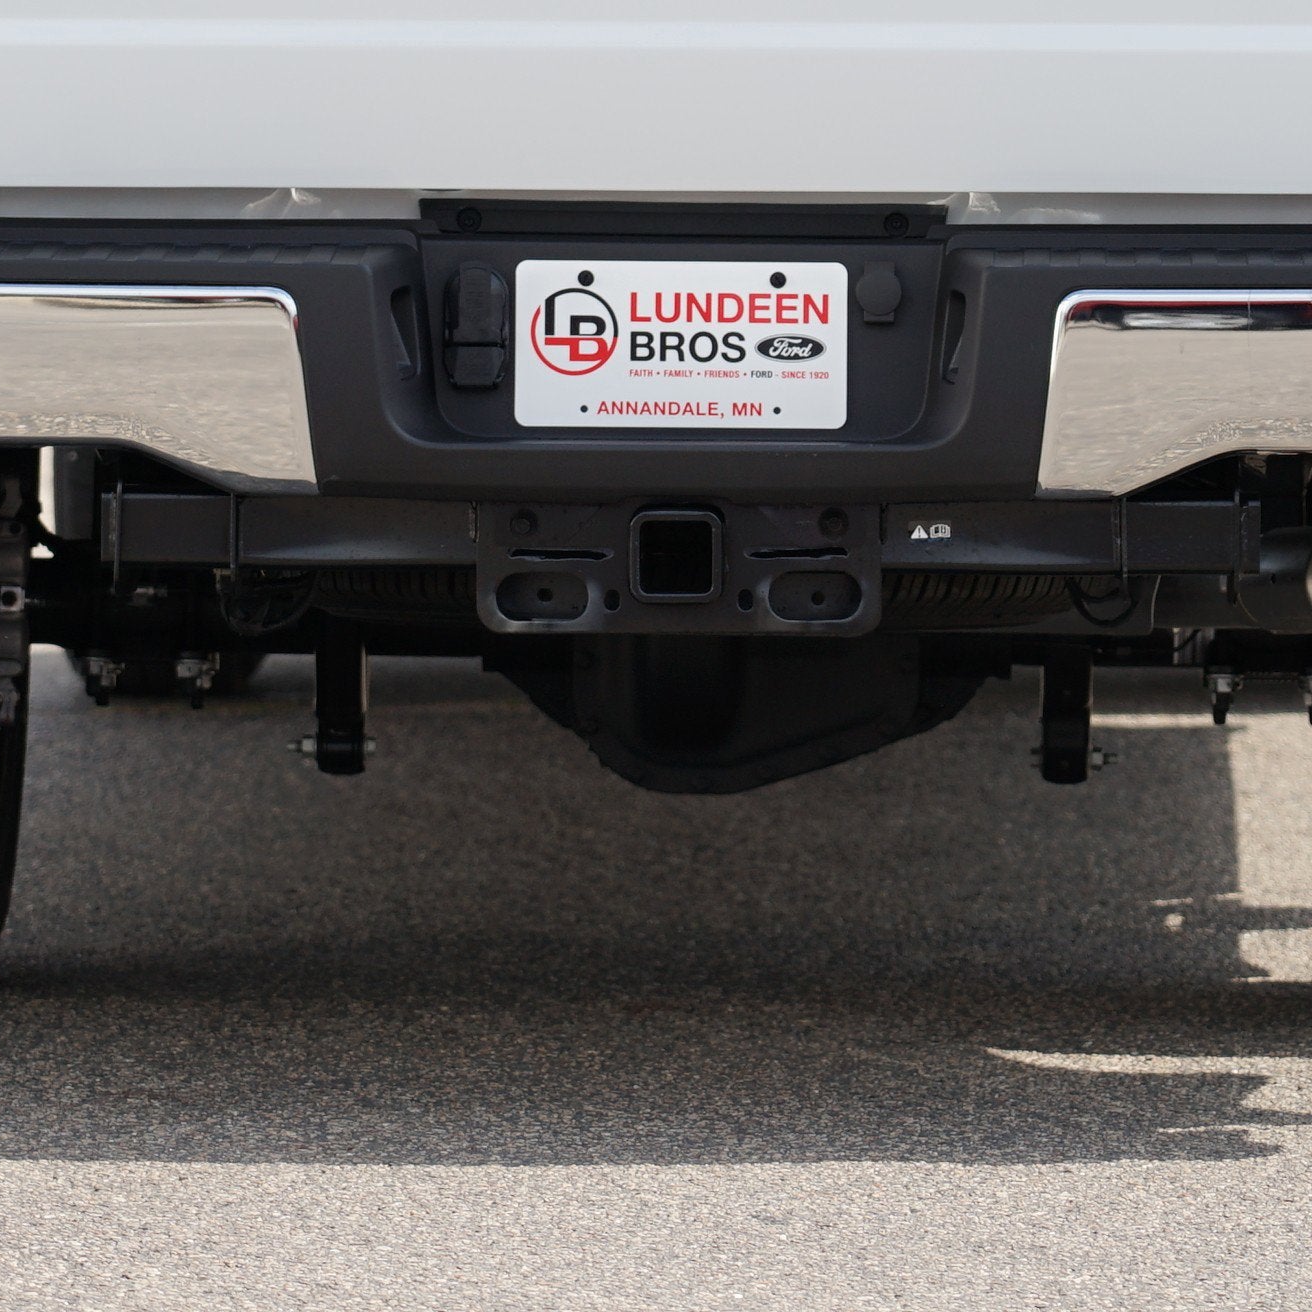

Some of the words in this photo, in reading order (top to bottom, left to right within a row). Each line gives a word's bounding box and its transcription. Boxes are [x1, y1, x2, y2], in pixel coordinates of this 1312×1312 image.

[629, 292, 830, 325] LUNDEEN
[629, 331, 747, 363] BROS
[768, 337, 812, 358] Ford
[629, 369, 653, 378] FAITH
[663, 369, 694, 378] FAMILY
[704, 370, 740, 379] FRIENDS
[750, 370, 773, 379] FORD
[781, 371, 806, 379] SINCE
[809, 371, 830, 380] 1920
[597, 401, 725, 419] ANNANDALE,
[732, 402, 763, 417] MN
